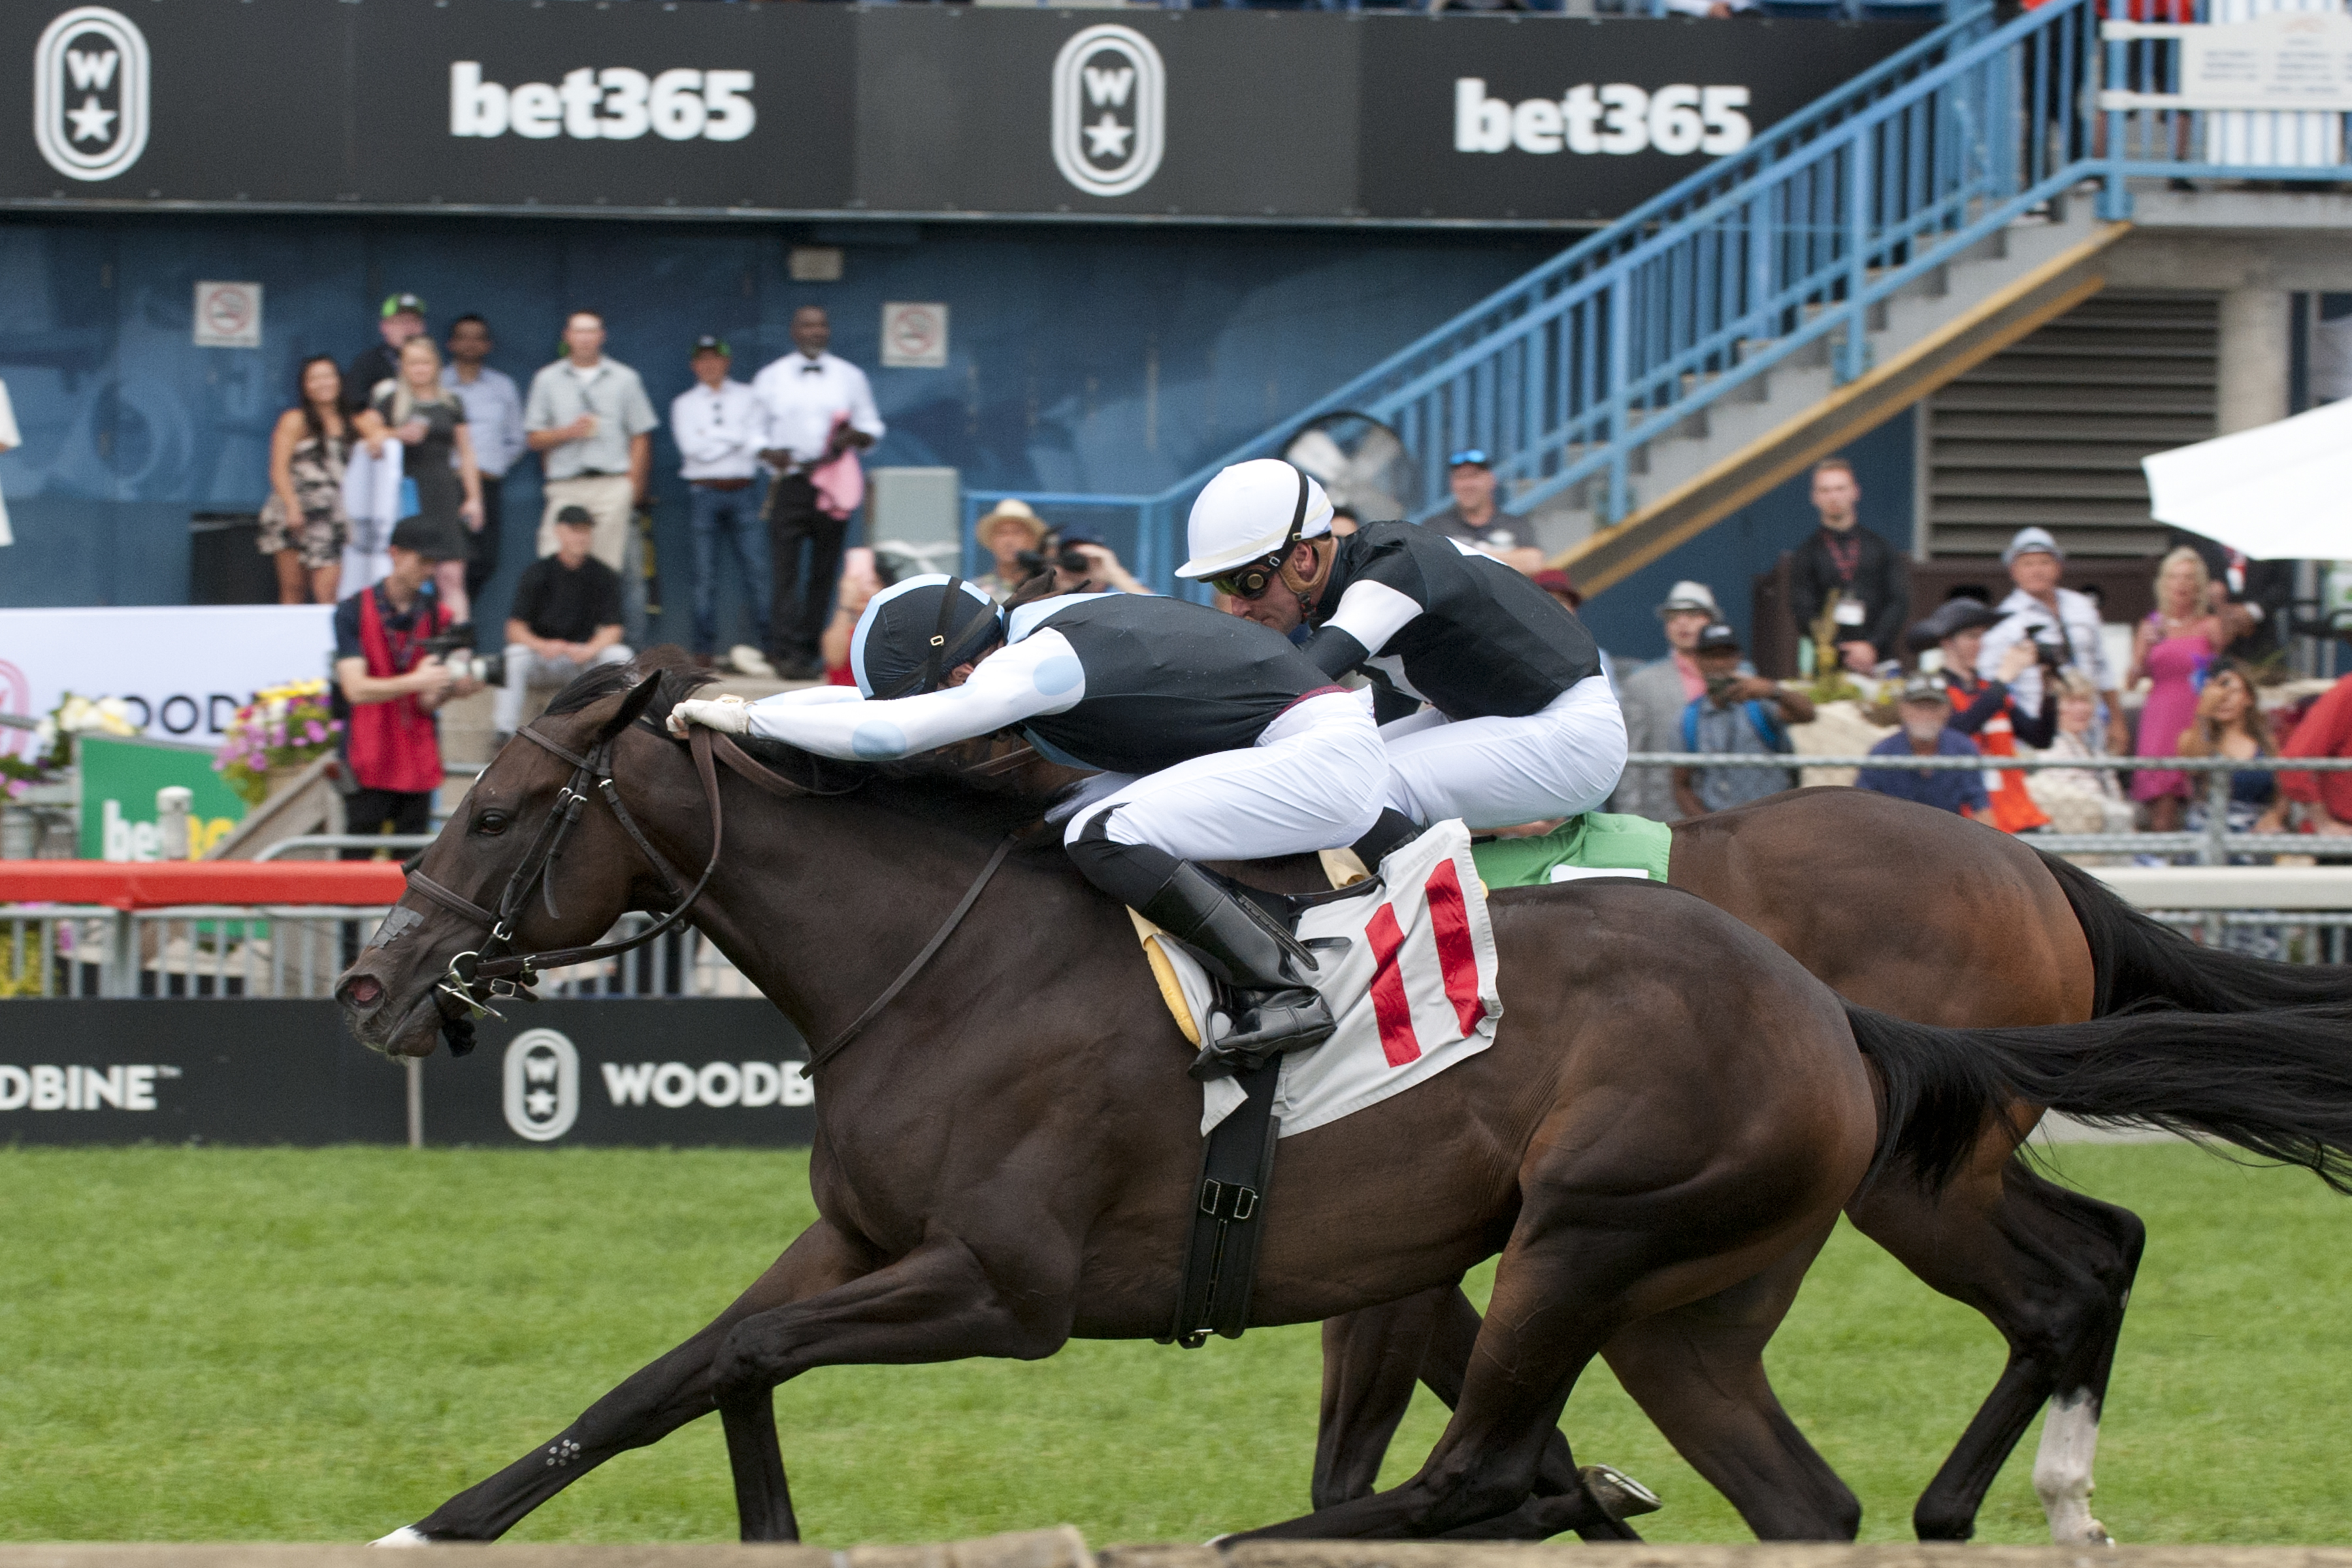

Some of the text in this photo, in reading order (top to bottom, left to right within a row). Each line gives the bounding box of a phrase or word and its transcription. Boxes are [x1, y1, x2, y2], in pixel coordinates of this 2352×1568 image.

[67, 50, 118, 90] W
[1085, 66, 1134, 106] W
[451, 61, 757, 141] bet365
[1454, 77, 1752, 155] bet365
[110, 694, 240, 734] OOD
[1365, 858, 1488, 1068] 11
[601, 1061, 815, 1108] WOODB
